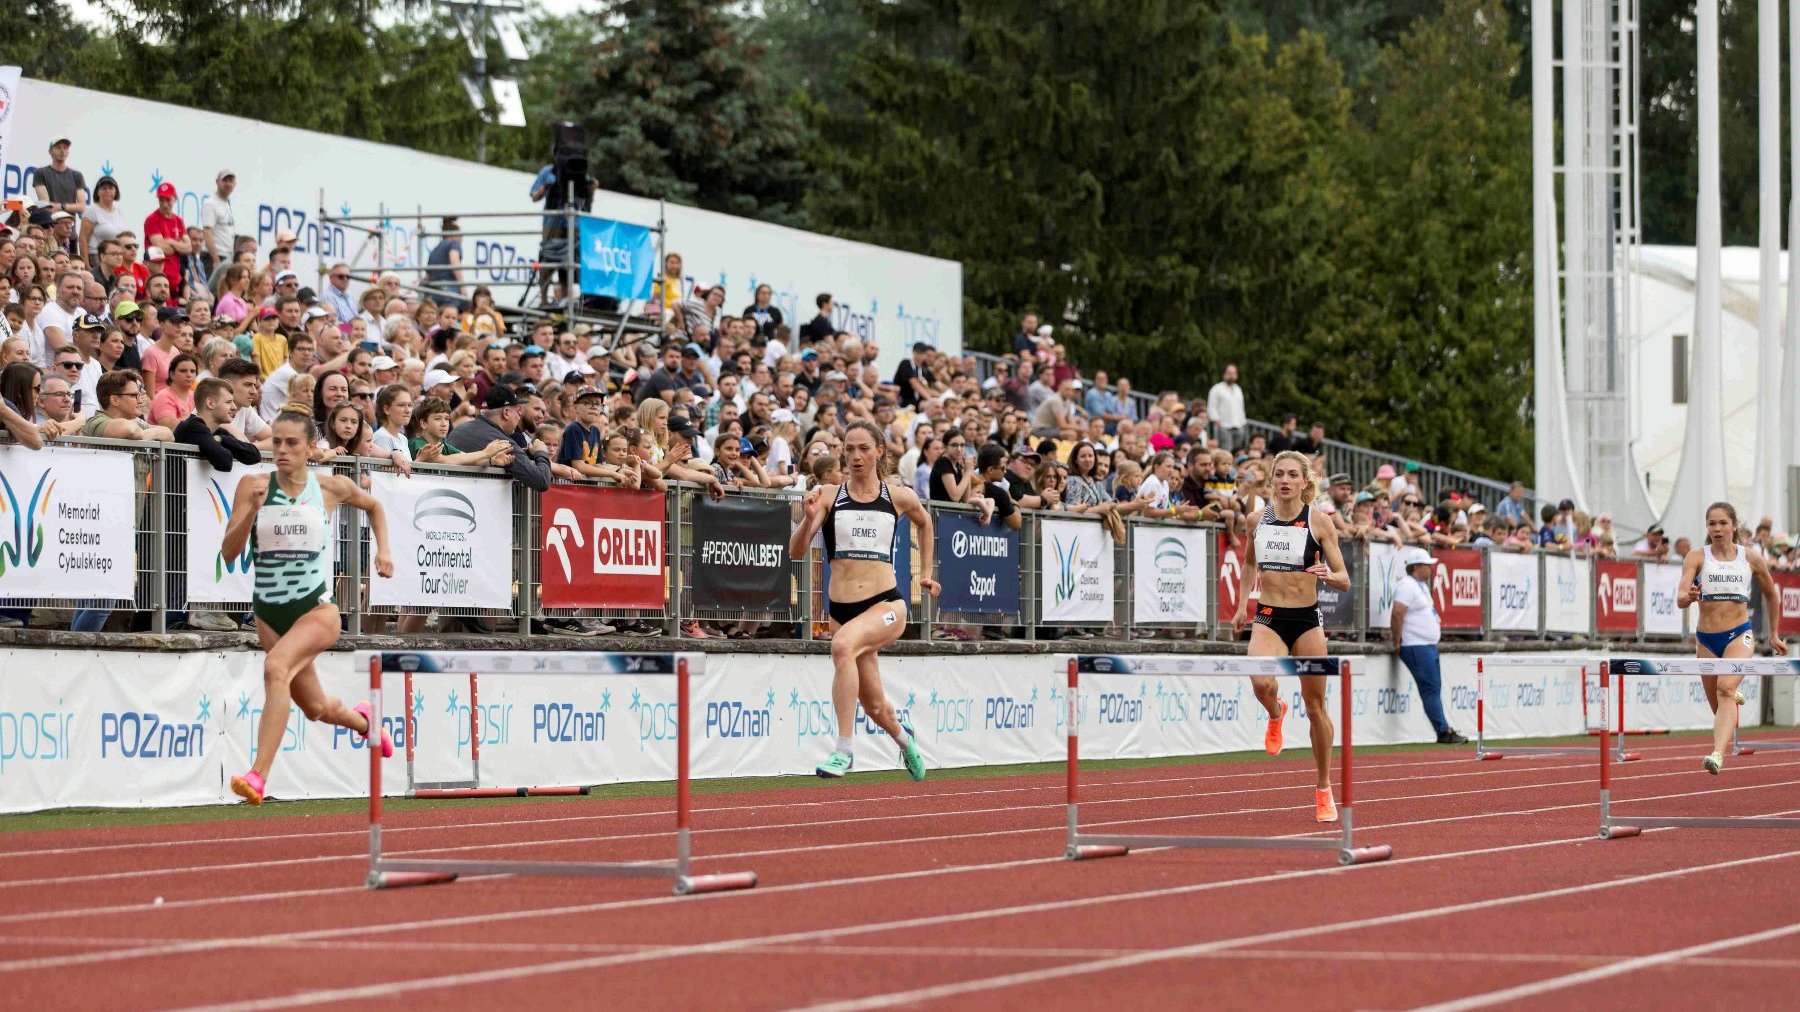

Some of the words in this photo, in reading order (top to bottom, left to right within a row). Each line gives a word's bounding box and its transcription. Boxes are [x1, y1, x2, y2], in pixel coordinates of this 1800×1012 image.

[58, 502, 101, 521] Memoriał
[58, 528, 101, 547] Czesława
[274, 524, 308, 536] OLIVIERI
[852, 527, 877, 538] DEMES
[417, 544, 473, 569] Continental
[597, 525, 657, 567] ORLEN
[702, 540, 784, 568] #PERSONALBEST
[969, 534, 1008, 558] HYUNDAI
[1265, 540, 1290, 551] JICHOVA
[58, 552, 113, 574] Cybulskiego
[420, 571, 441, 594] Tour
[441, 571, 469, 595] Silver
[969, 570, 996, 601] Szpot
[985, 696, 1034, 730] POZnan
[1100, 693, 1143, 724] POZnan
[1199, 691, 1239, 721] POZnan
[533, 702, 606, 743] POZnan
[706, 700, 770, 739] POZnan
[102, 711, 203, 758] POZnan
